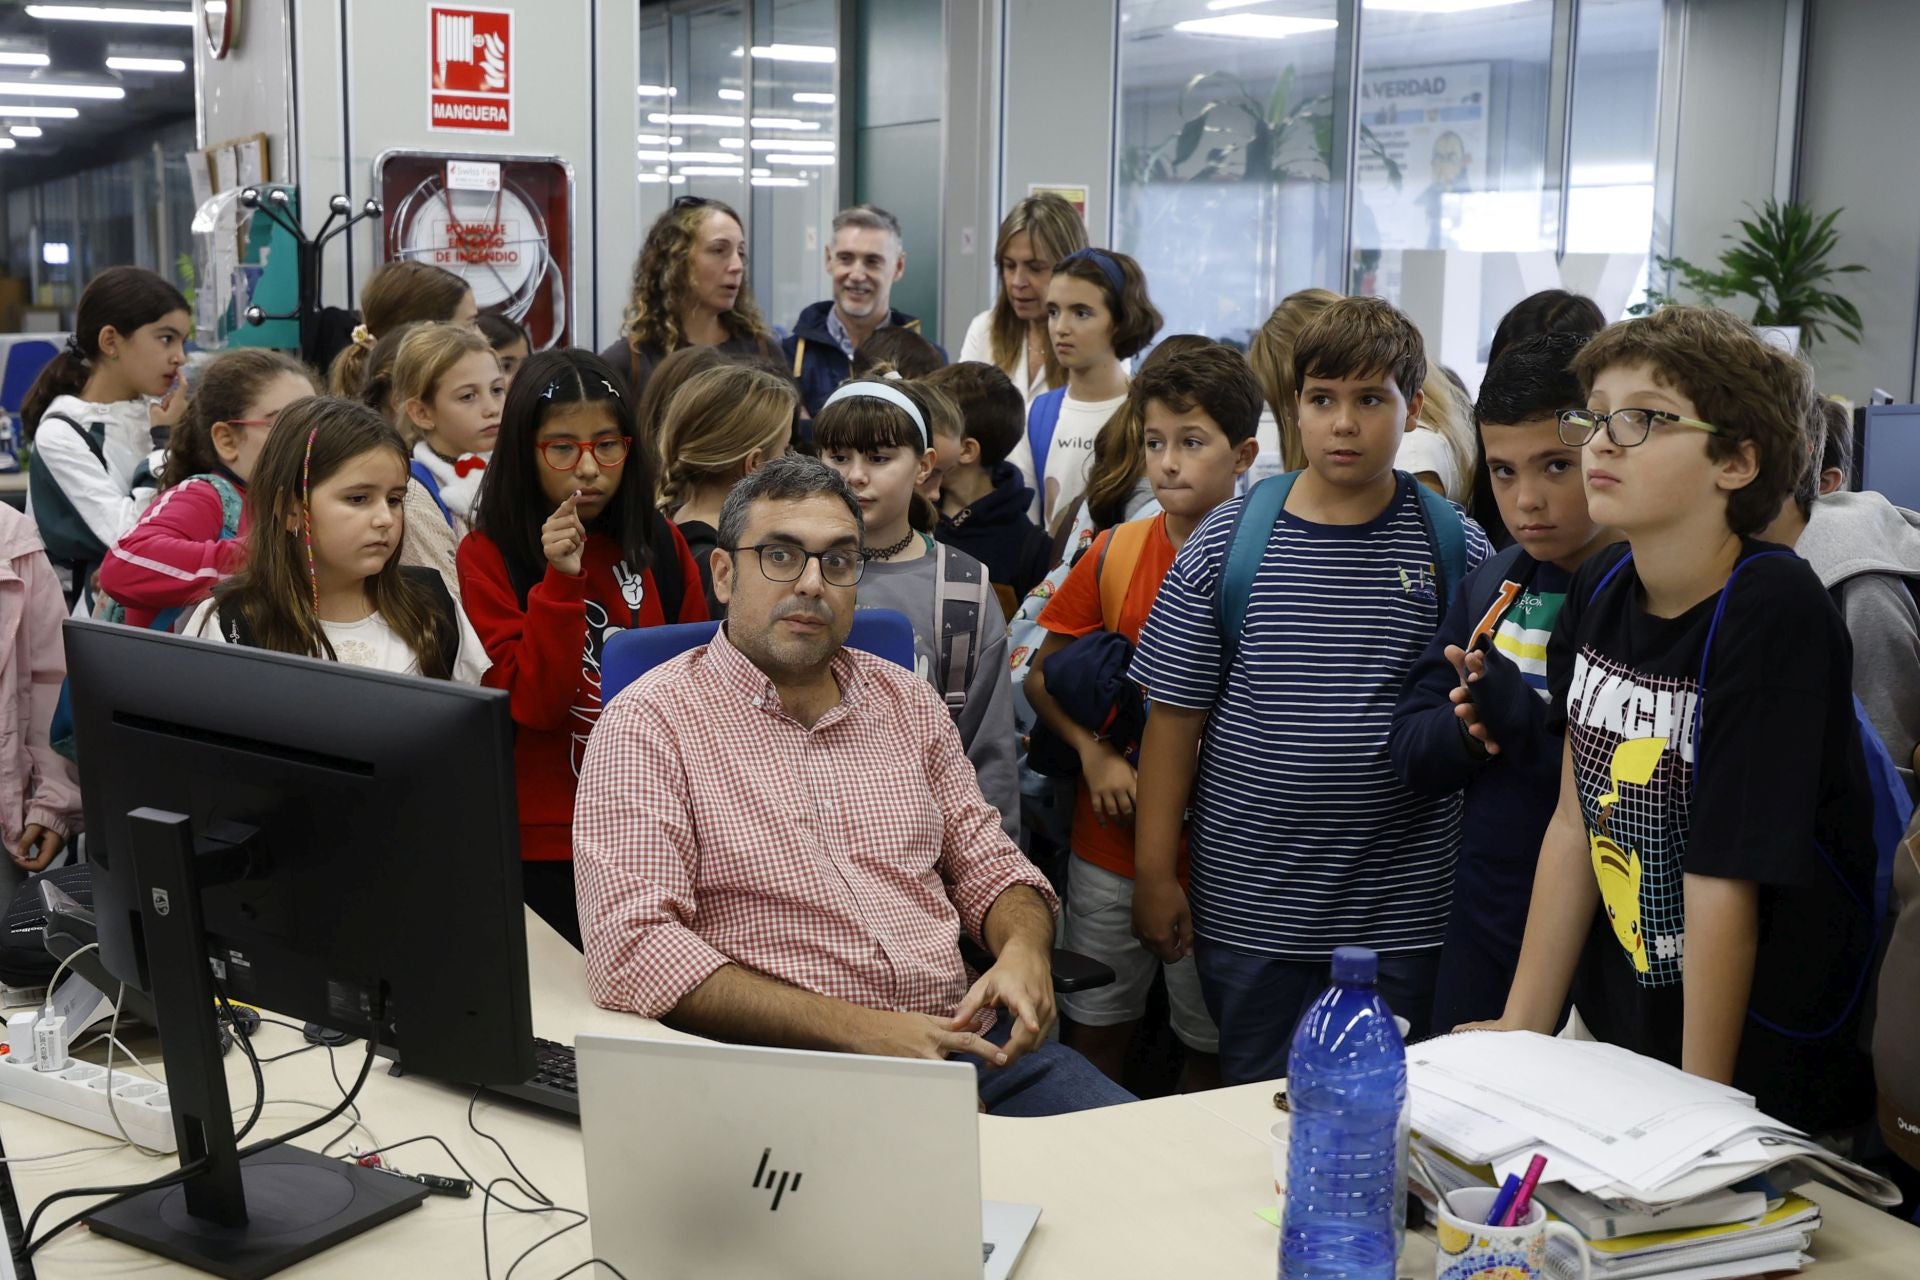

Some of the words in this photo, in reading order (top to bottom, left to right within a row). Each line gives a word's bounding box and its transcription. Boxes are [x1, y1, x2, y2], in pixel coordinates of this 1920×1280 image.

[1373, 76, 1447, 98] VERDAD
[433, 103, 508, 122] MANGUERA
[436, 252, 451, 262] DE
[752, 1147, 802, 1211] hp
